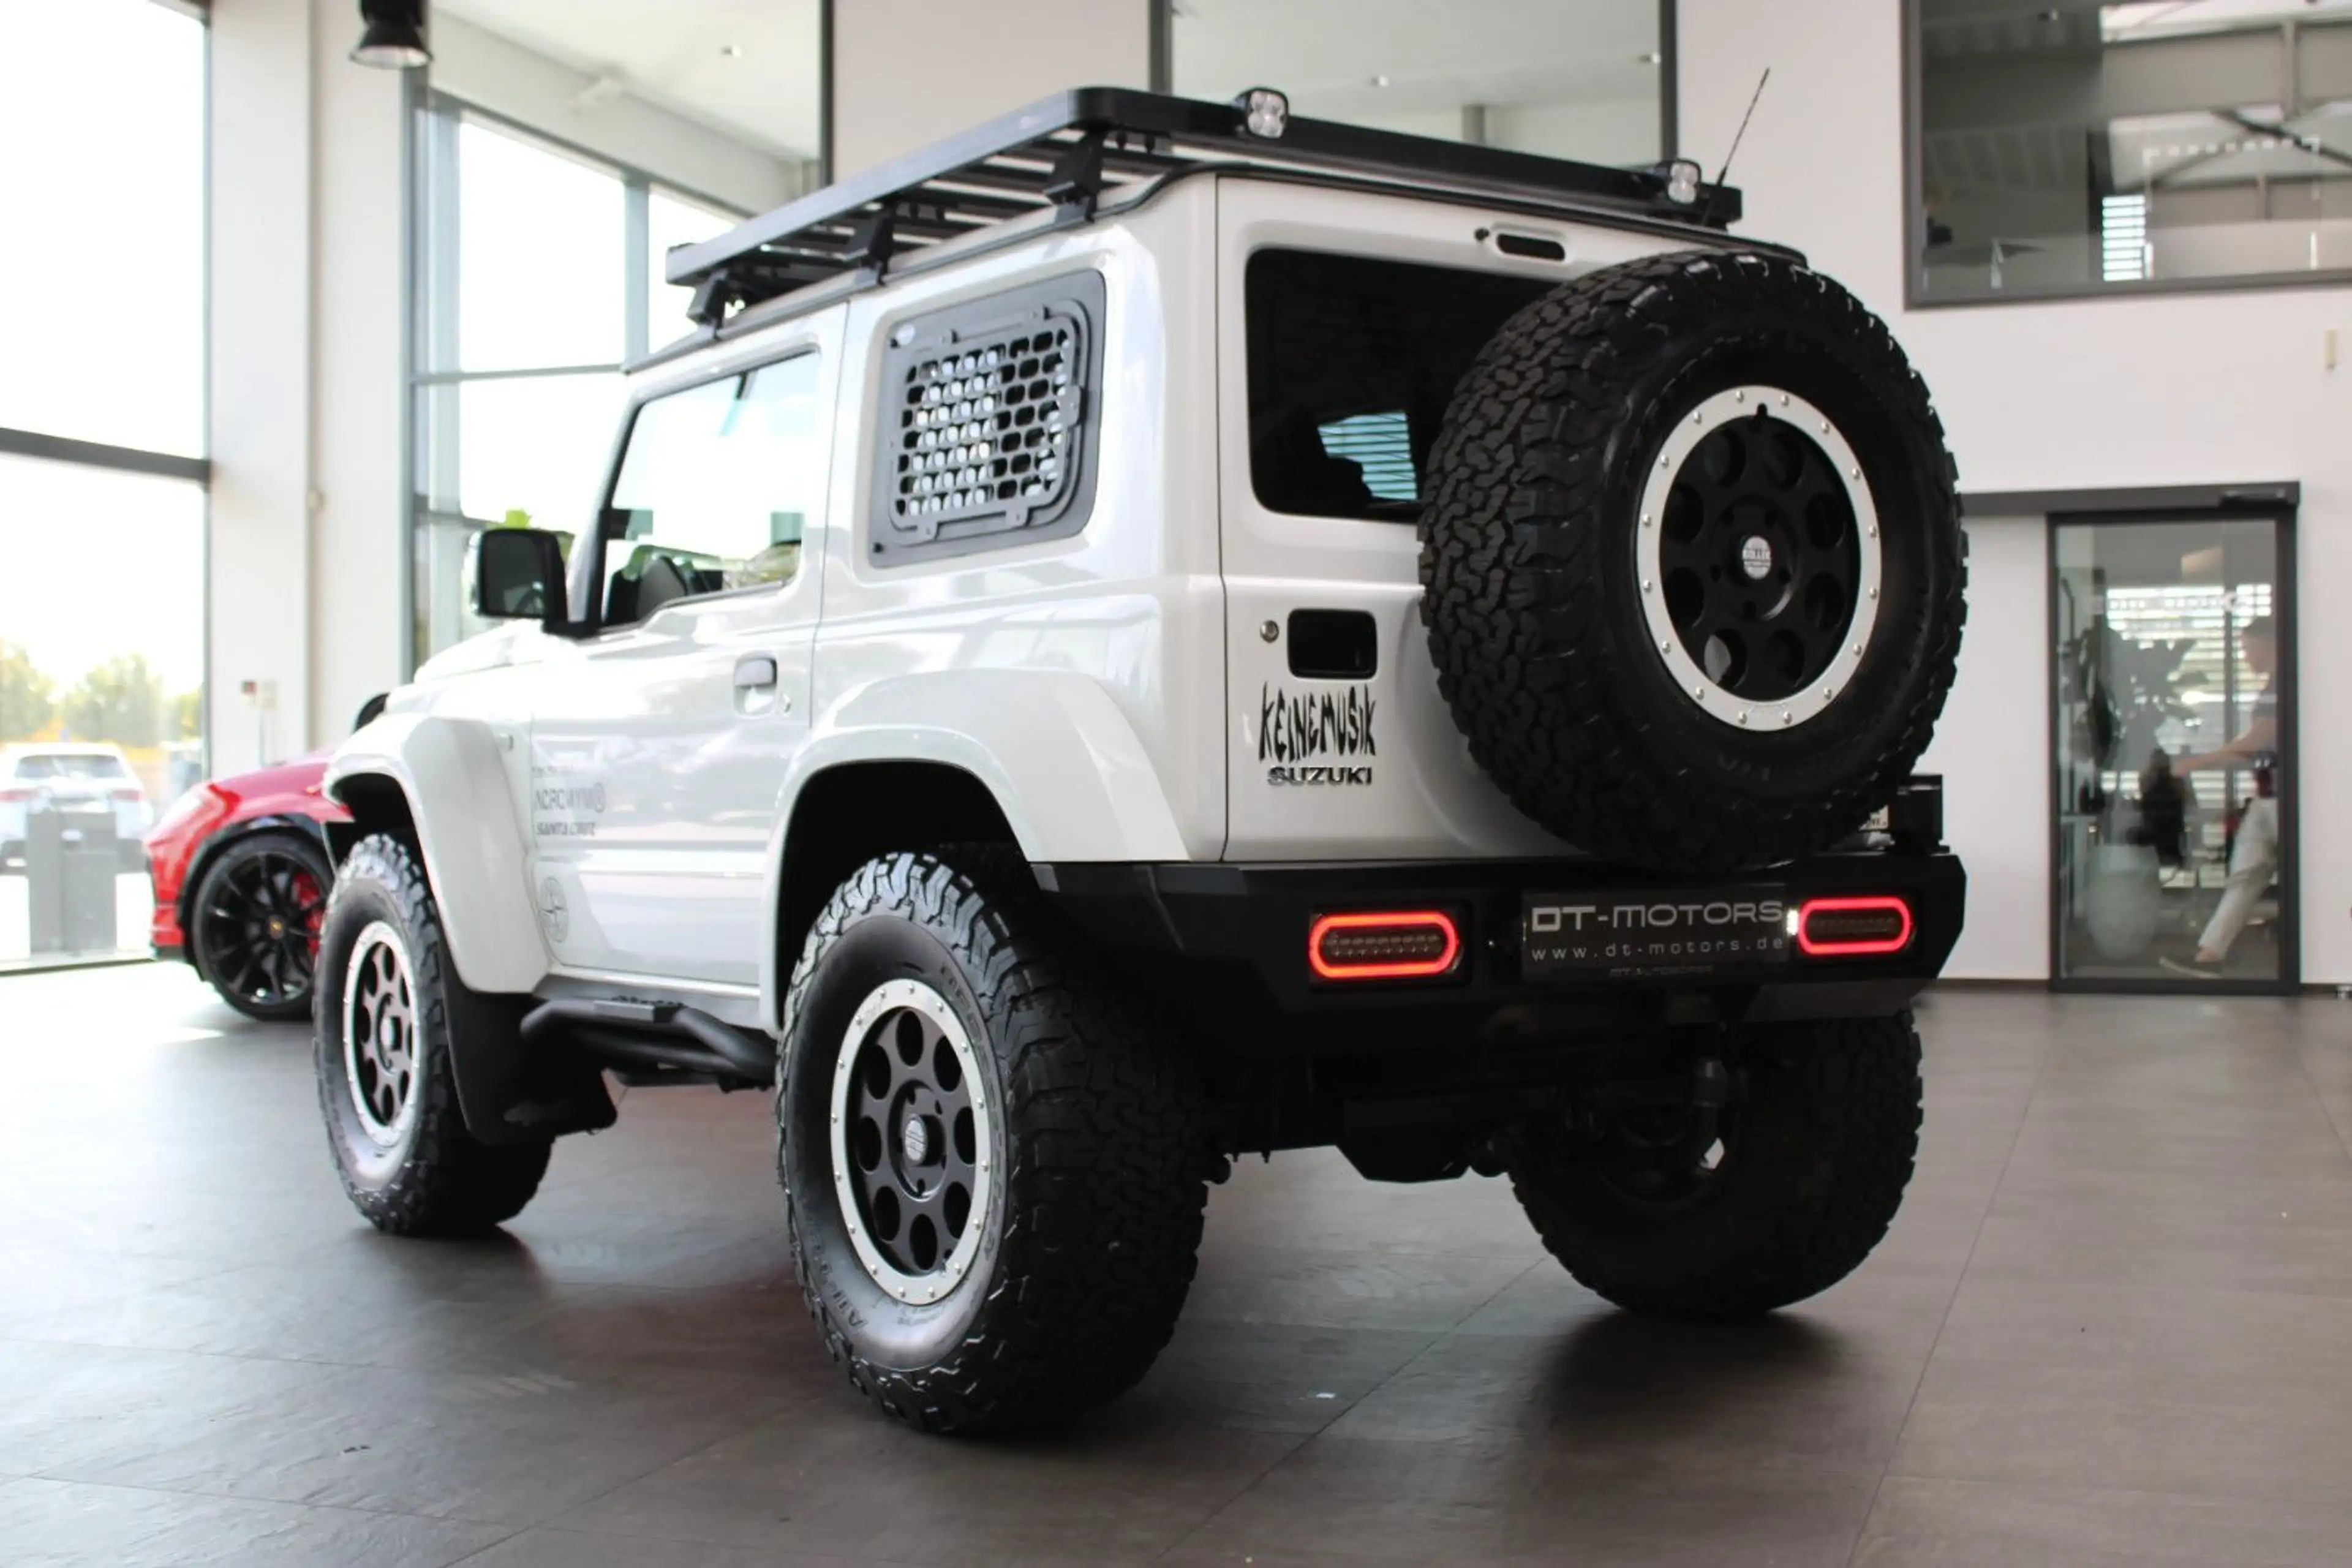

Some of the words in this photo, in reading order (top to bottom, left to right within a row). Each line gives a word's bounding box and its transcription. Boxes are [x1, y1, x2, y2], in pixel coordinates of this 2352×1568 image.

[1259, 681, 1376, 763] KEINEMUSIK
[1267, 767, 1373, 786] SUZUKI
[1531, 901, 1783, 932] DT-MOTORS
[1531, 937, 1783, 961] www.dt-motors.de
